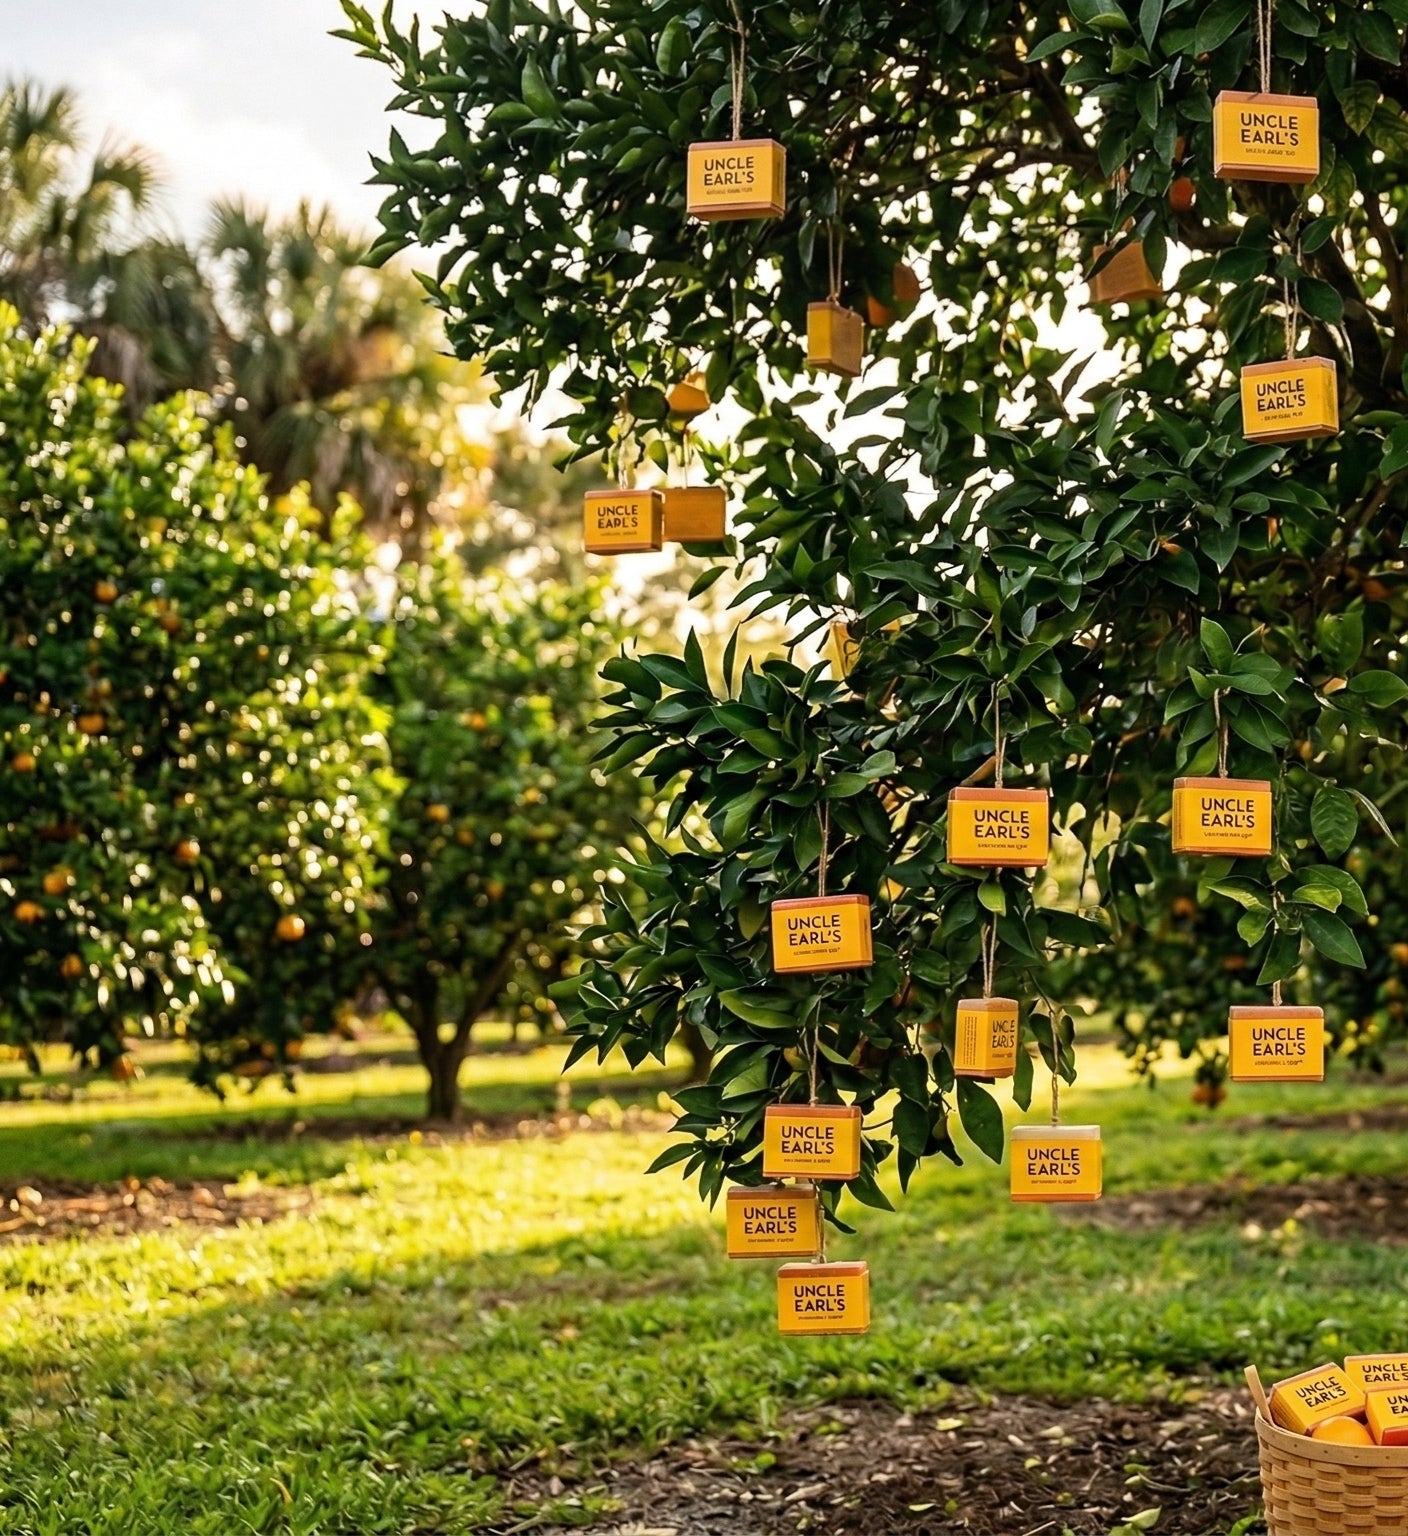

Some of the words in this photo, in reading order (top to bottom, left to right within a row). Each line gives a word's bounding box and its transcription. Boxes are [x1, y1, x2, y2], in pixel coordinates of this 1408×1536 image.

[1240, 112, 1298, 129] UNCLE
[1241, 129, 1299, 146] EARL'S
[704, 156, 754, 171] UNCLE
[704, 171, 754, 186] EARL'S
[1257, 378, 1304, 396] UNCLE
[1257, 394, 1305, 412] EARL'S
[597, 505, 637, 516] UNCLE
[1201, 798, 1254, 812] UNCLE
[974, 810, 1029, 823] UNCLE
[1201, 813, 1255, 828] EARL'S
[975, 825, 1030, 838] EARL'S
[788, 915, 840, 930] UNCLE
[789, 930, 841, 946] EARL'S
[1252, 1028, 1305, 1040] UNCLE
[1253, 1043, 1305, 1055] EARL'S
[781, 1126, 834, 1139] UNCLE
[781, 1141, 834, 1154] EARL'S
[1027, 1149, 1079, 1160] UNCLE
[1028, 1163, 1080, 1175] EARL'S
[744, 1206, 796, 1219] UNCLE
[745, 1220, 797, 1233] EARL'S
[794, 1285, 844, 1297] UNCLE
[795, 1299, 845, 1312] EARL'S
[1363, 1362, 1408, 1372] UNCLE
[1296, 1376, 1340, 1398] UNCLE
